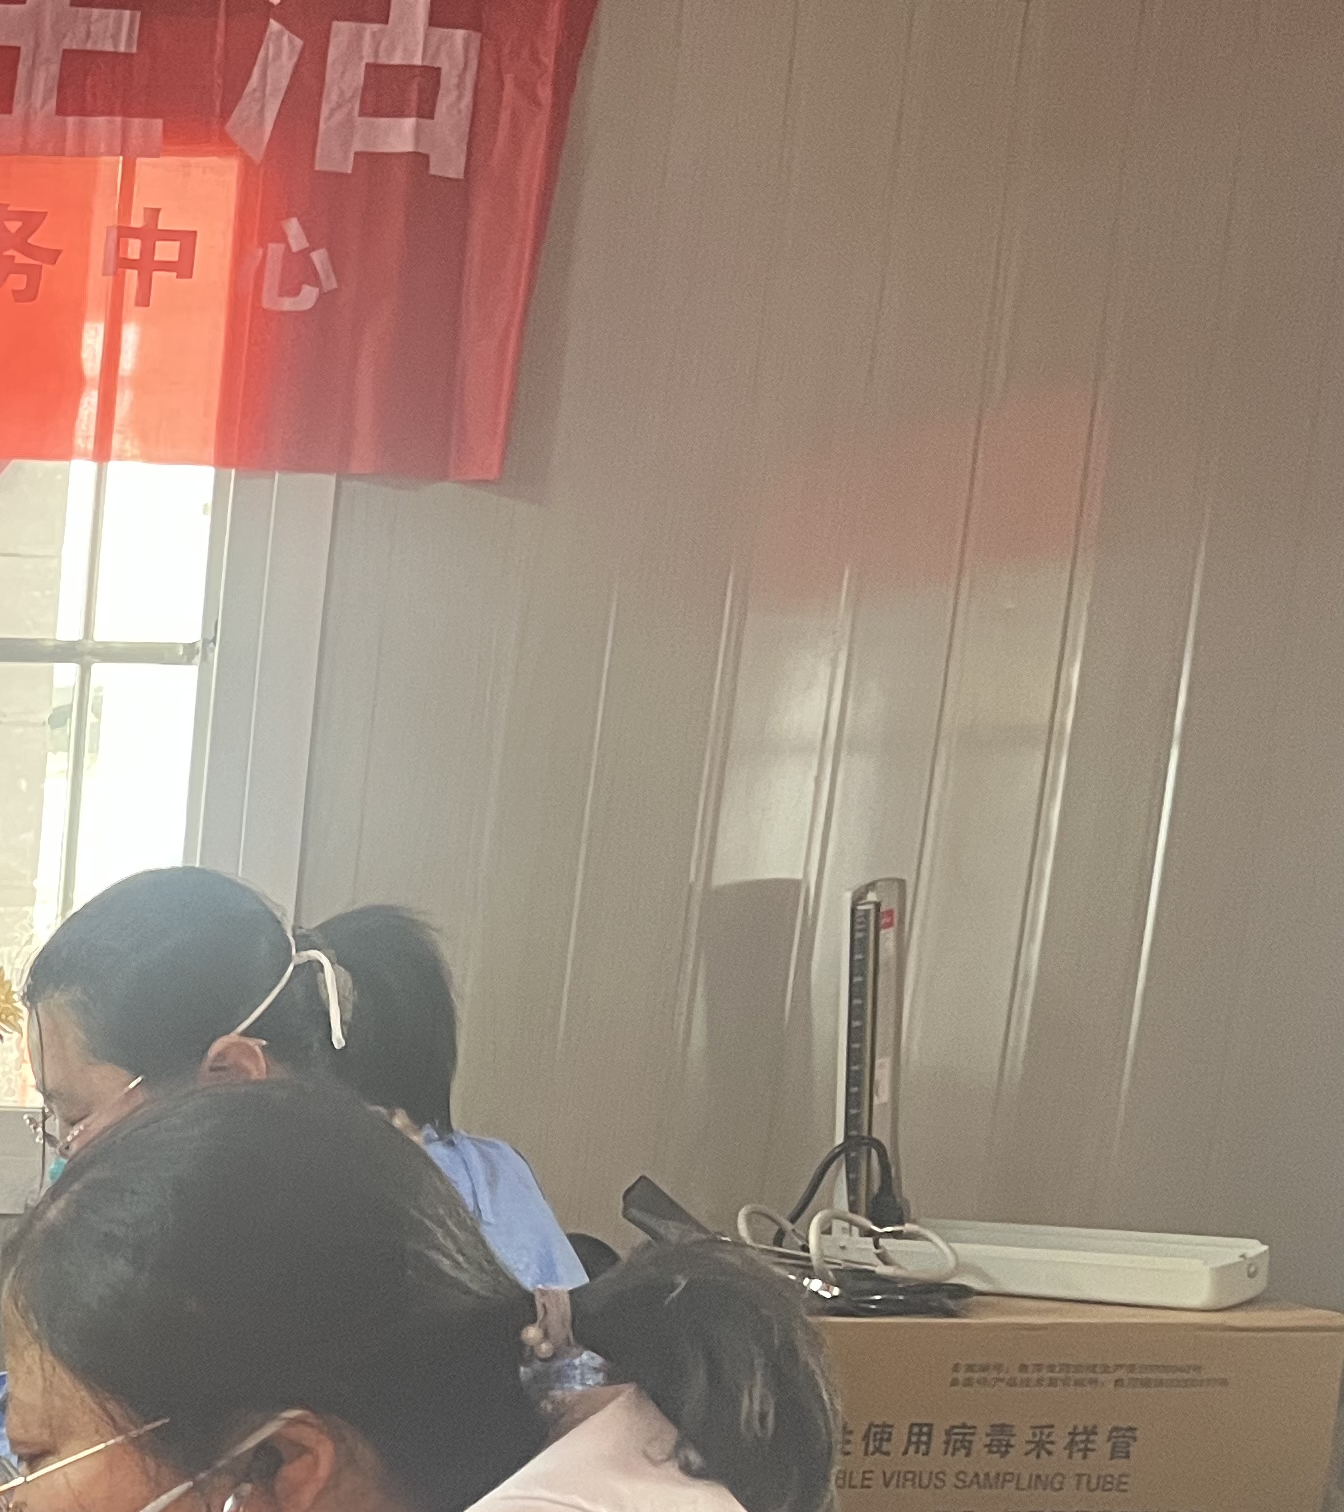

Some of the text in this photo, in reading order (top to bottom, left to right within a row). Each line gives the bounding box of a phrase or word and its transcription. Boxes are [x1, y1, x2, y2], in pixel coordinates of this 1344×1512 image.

[882, 1470, 949, 1490] VIRUS
[954, 1470, 1066, 1492] SAMPLING
[1073, 1472, 1131, 1493] TUBE
